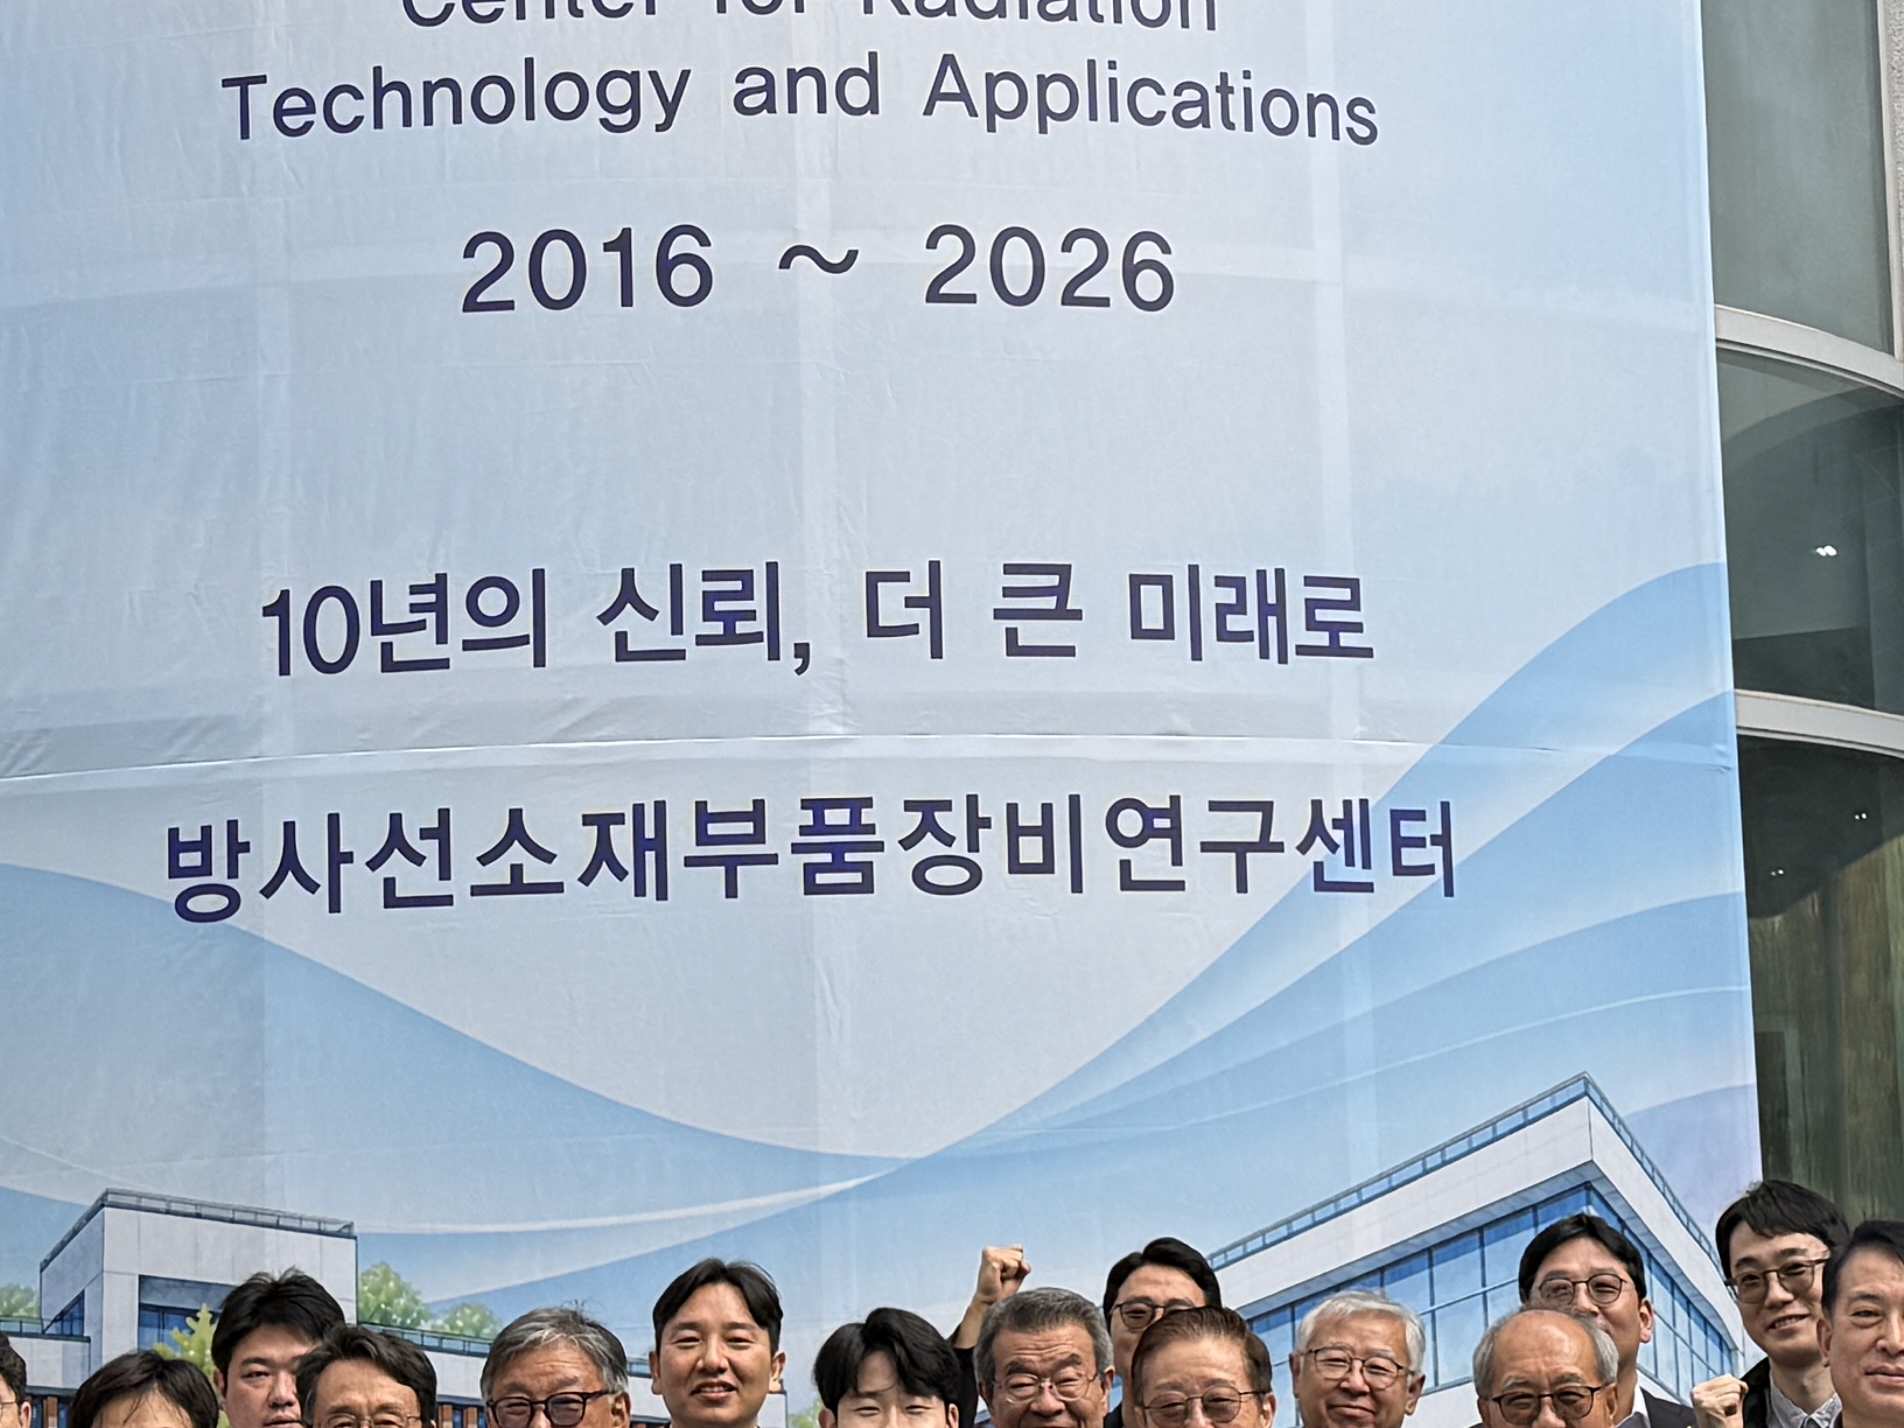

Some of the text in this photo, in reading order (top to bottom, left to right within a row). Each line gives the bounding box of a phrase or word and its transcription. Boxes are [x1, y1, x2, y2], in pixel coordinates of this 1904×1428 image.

[220, 50, 1379, 147] Technology and Applications
[460, 223, 714, 314] 2016
[924, 223, 1175, 313] 2026
[260, 559, 1375, 678] 10년의 신뢰, 더 큰 미래로
[166, 792, 1455, 925] 방사선소재부품장비연구센터
